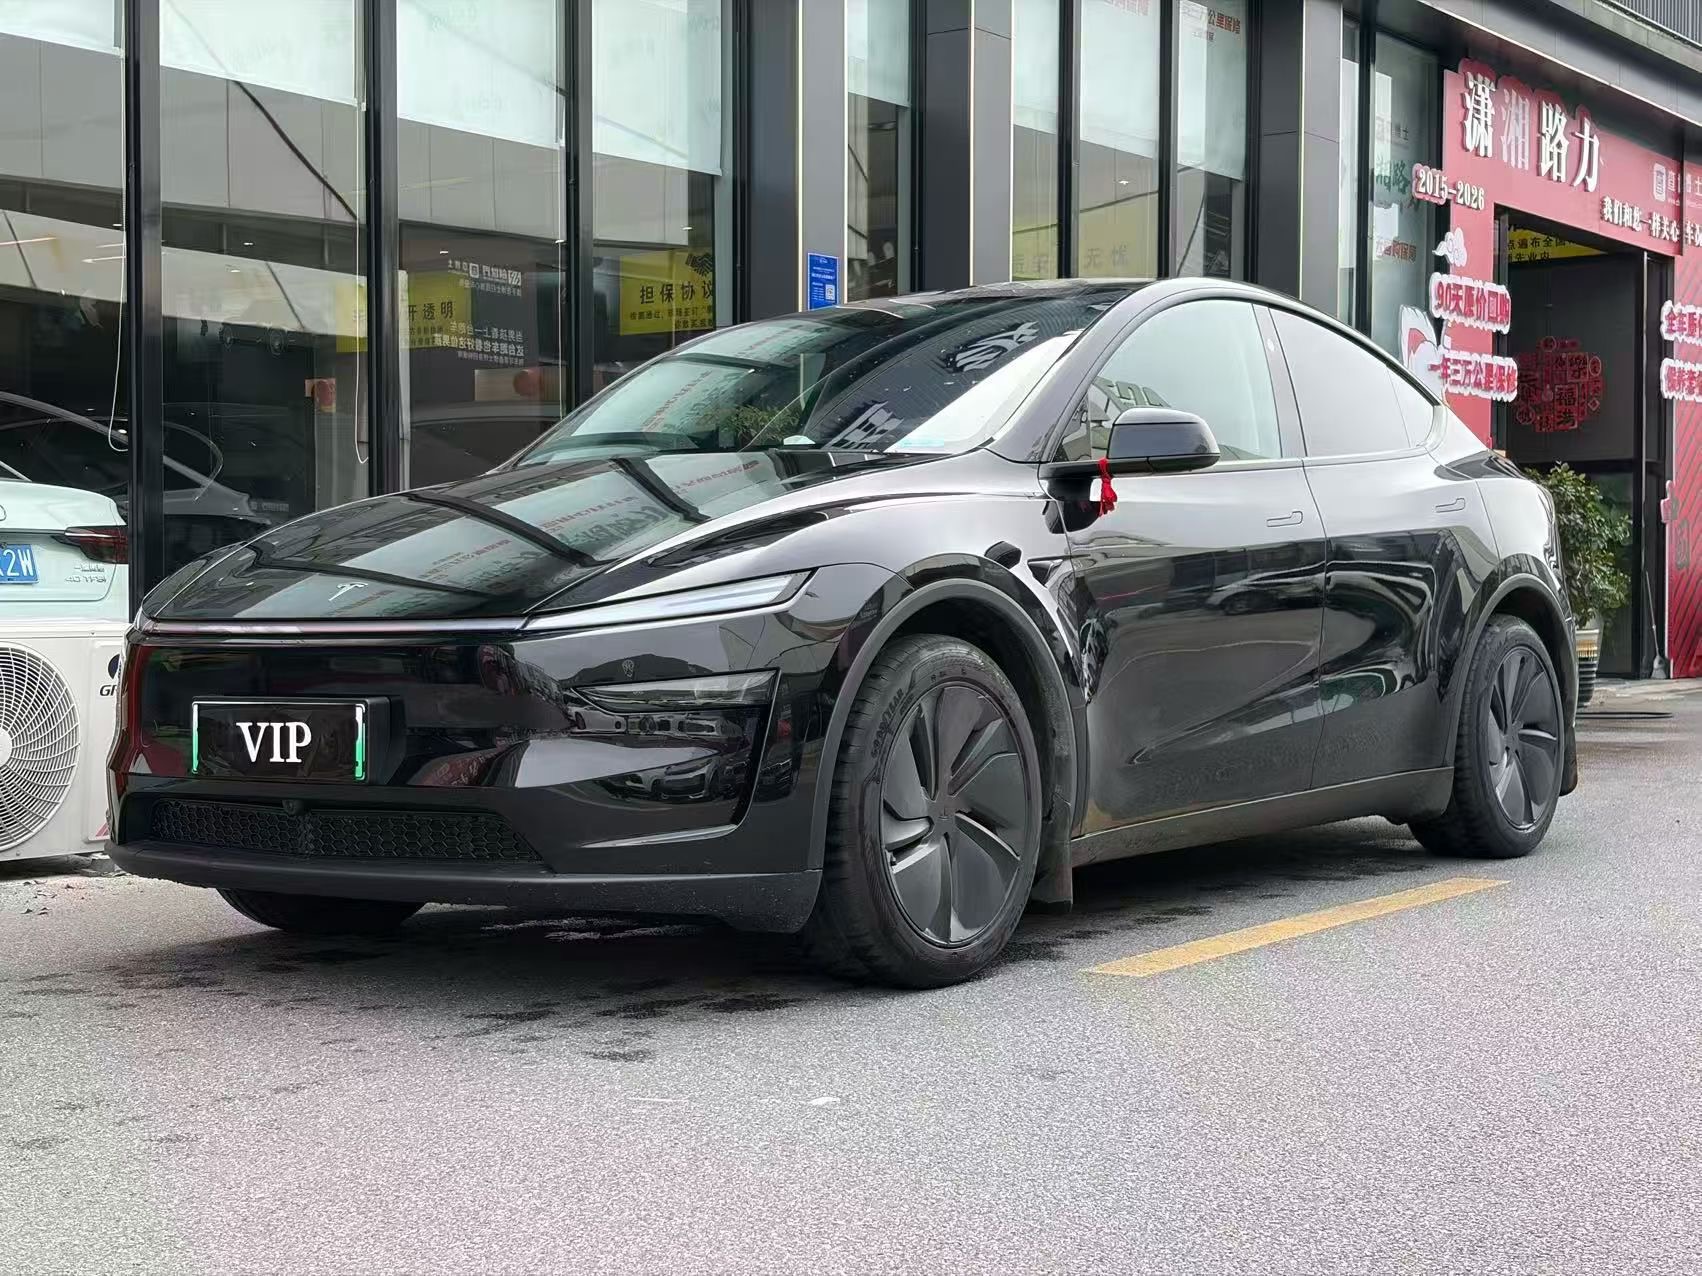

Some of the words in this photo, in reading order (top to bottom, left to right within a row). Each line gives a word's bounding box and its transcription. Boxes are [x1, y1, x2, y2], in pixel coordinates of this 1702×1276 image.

[1416, 168, 1486, 210] 2015-2026
[640, 281, 713, 305] 担保协议
